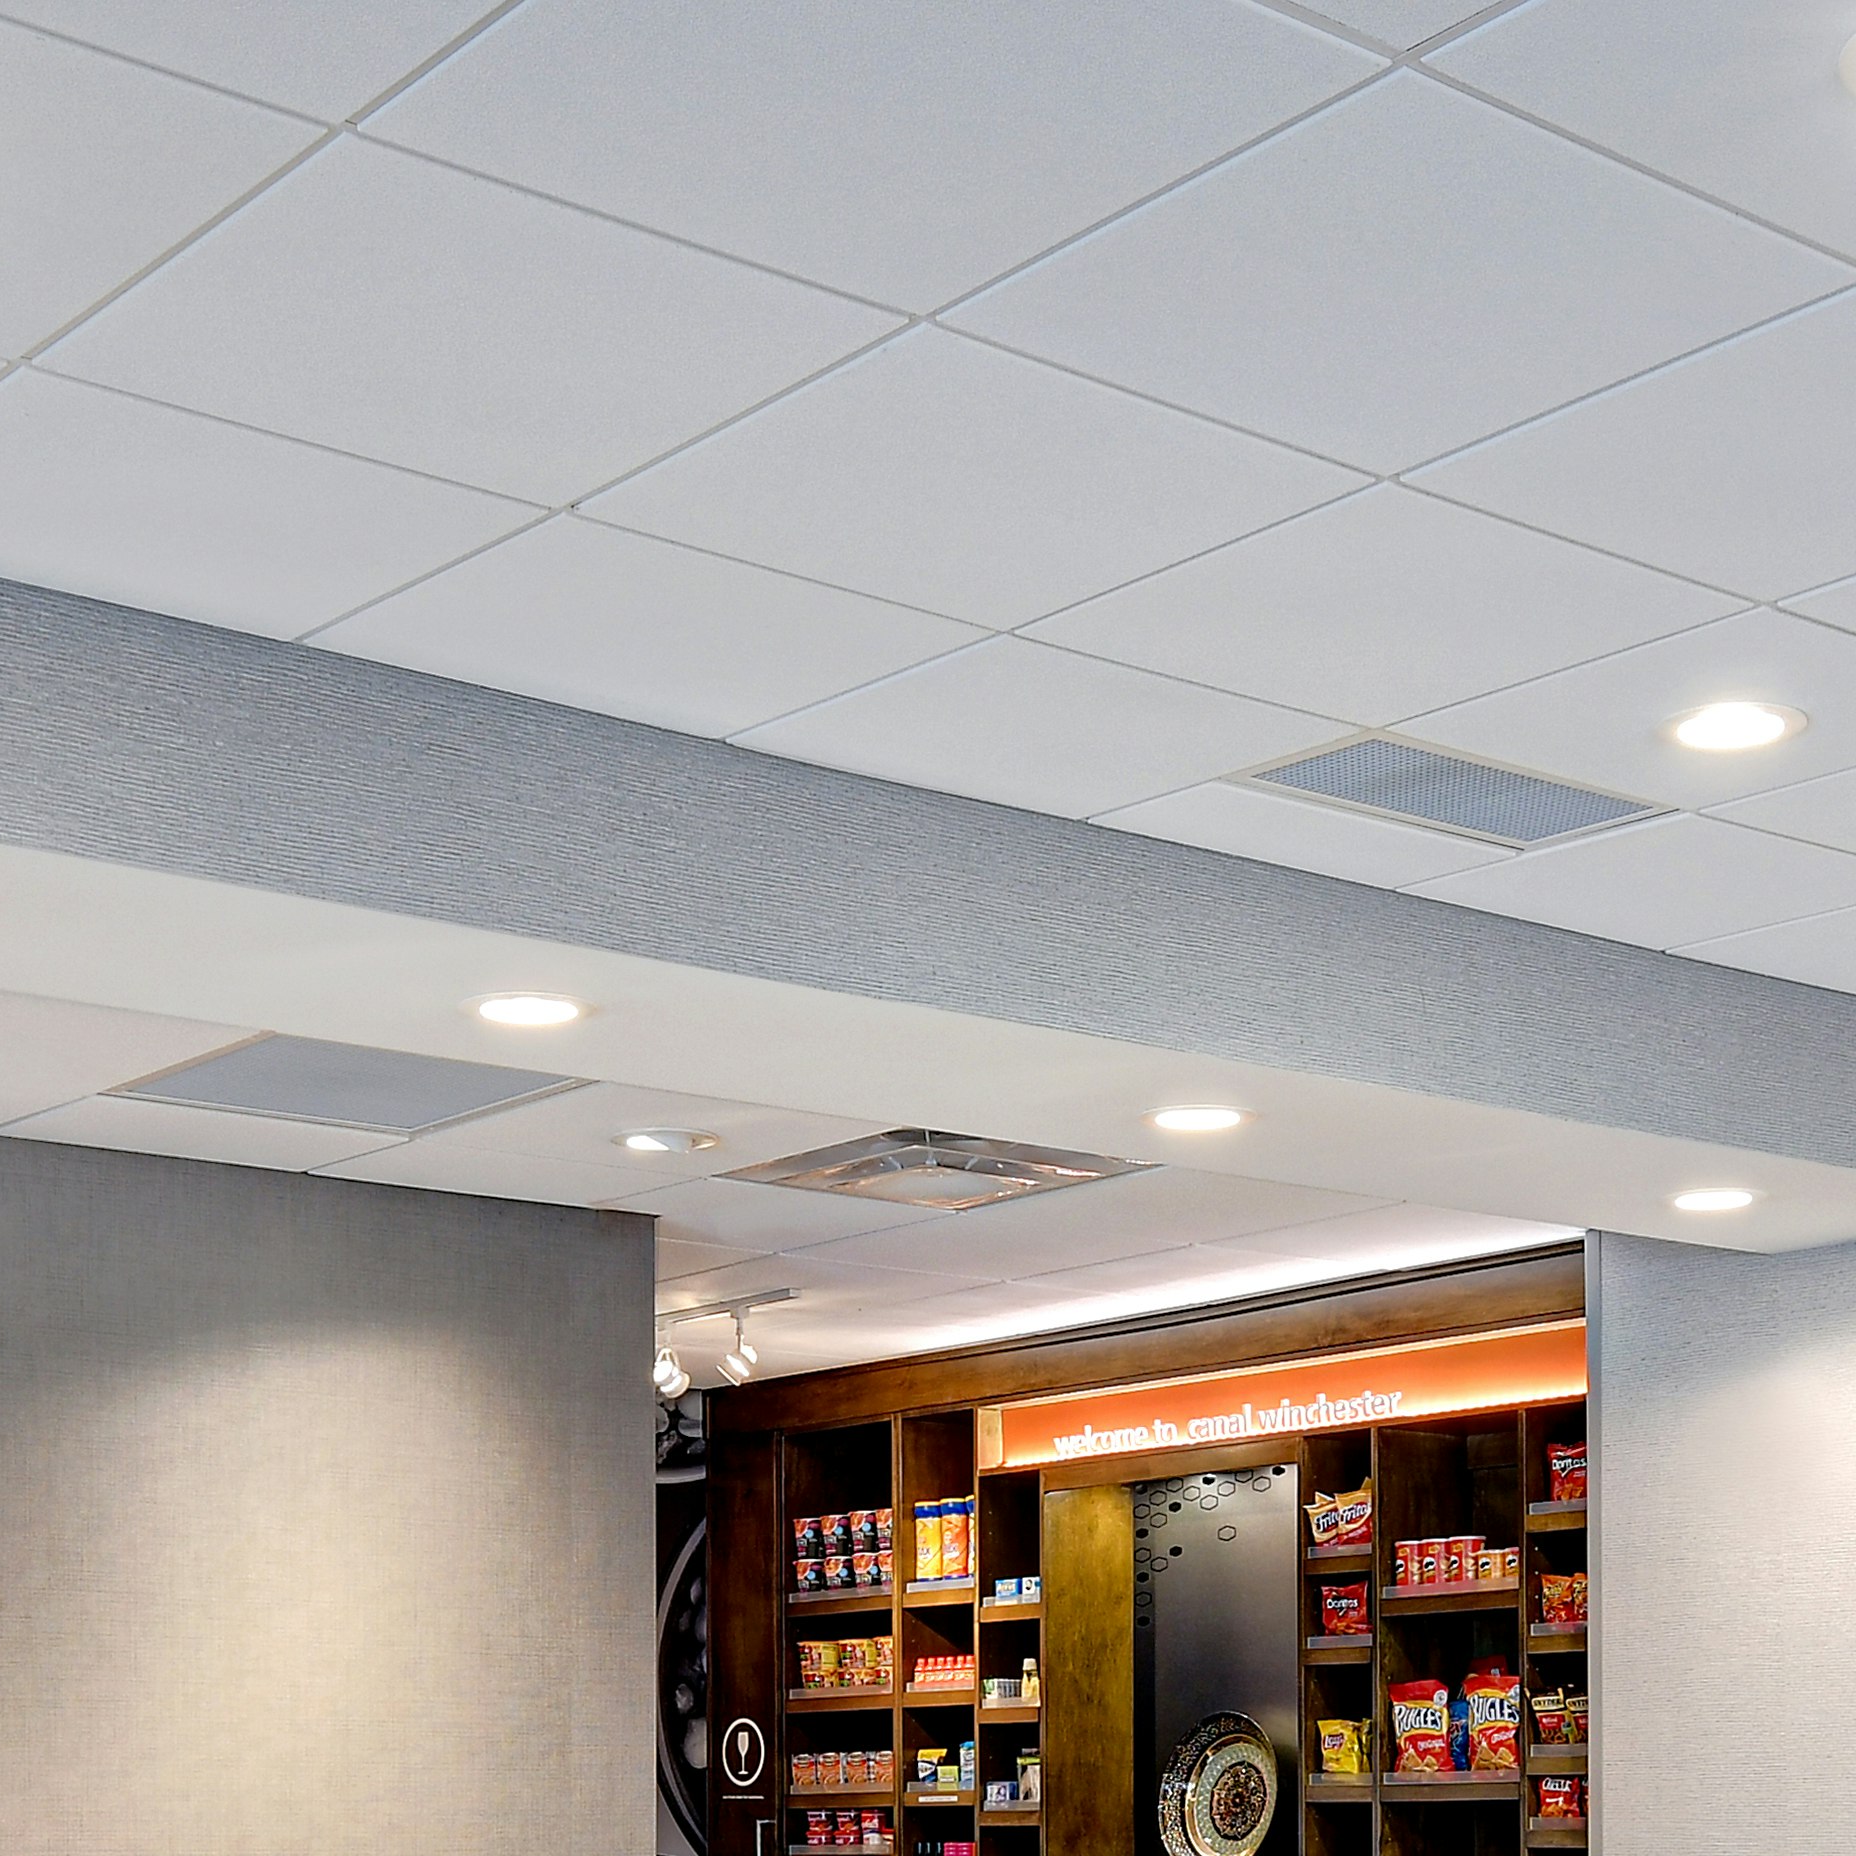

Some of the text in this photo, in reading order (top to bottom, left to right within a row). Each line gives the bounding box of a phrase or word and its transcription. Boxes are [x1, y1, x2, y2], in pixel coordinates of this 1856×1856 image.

[1053, 1389, 1403, 1457] welcome to canal winchester
